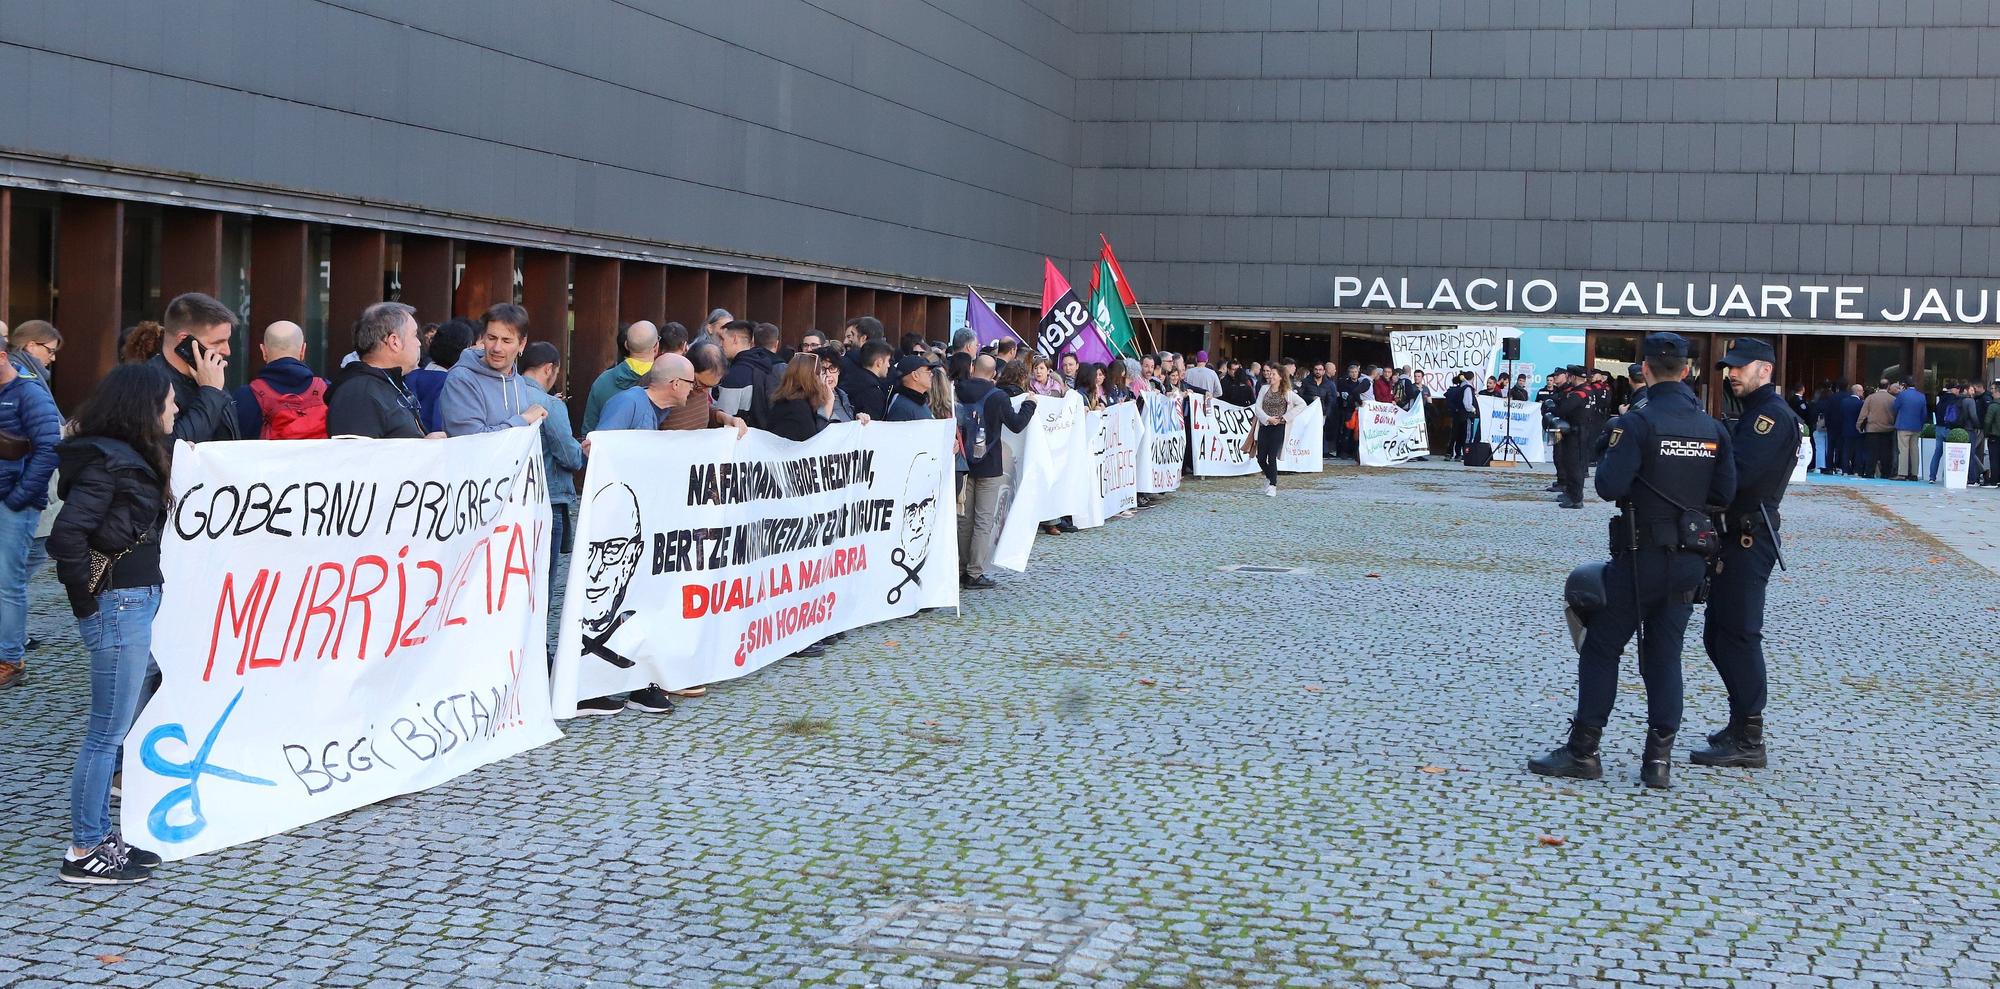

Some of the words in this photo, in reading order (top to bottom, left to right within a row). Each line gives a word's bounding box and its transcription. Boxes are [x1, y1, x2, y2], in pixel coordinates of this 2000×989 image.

[1334, 276, 1557, 313] PALACIO
[1579, 280, 1864, 320] BALUARTE
[1880, 287, 2000, 324] JAU
[1660, 440, 1706, 450] POLICIA
[1660, 448, 1715, 458] NACIONAL
[174, 481, 378, 541] GOBERNU
[652, 526, 732, 576] BERTZE
[682, 576, 754, 620] DUAL
[757, 570, 767, 604] A
[769, 563, 793, 598] LA
[734, 617, 773, 667] ¿SIN
[776, 591, 837, 648] HORAS?
